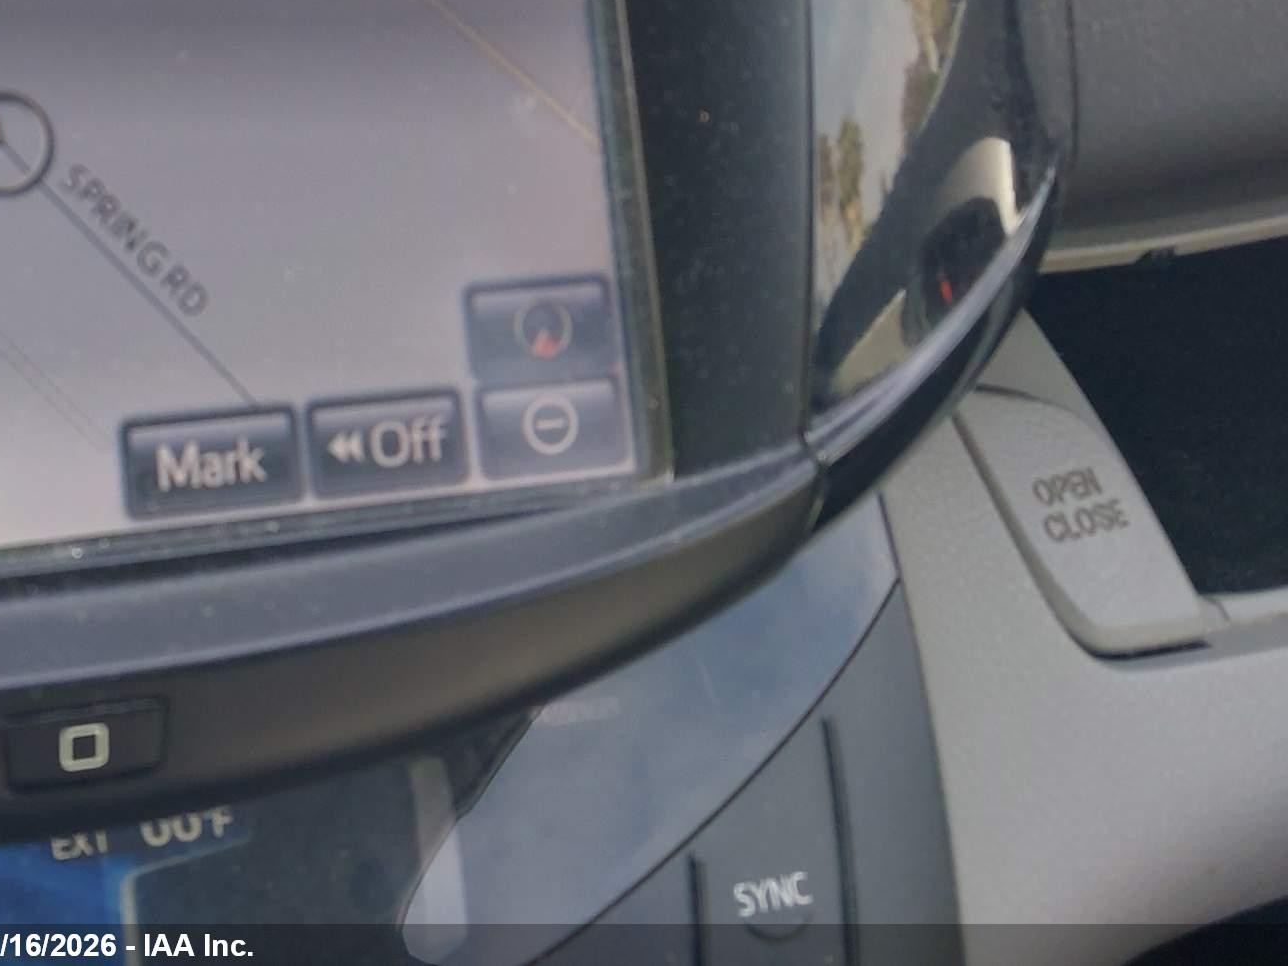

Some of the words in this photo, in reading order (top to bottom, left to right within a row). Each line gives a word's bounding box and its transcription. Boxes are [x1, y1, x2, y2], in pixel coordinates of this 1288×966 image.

[61, 163, 170, 277] SPRING
[161, 264, 210, 317] RD
[155, 436, 268, 493] Mark
[370, 416, 447, 468] Off
[1032, 467, 1103, 507] OPEN
[1043, 498, 1130, 543] CLOSE
[733, 871, 814, 918] SYNC
